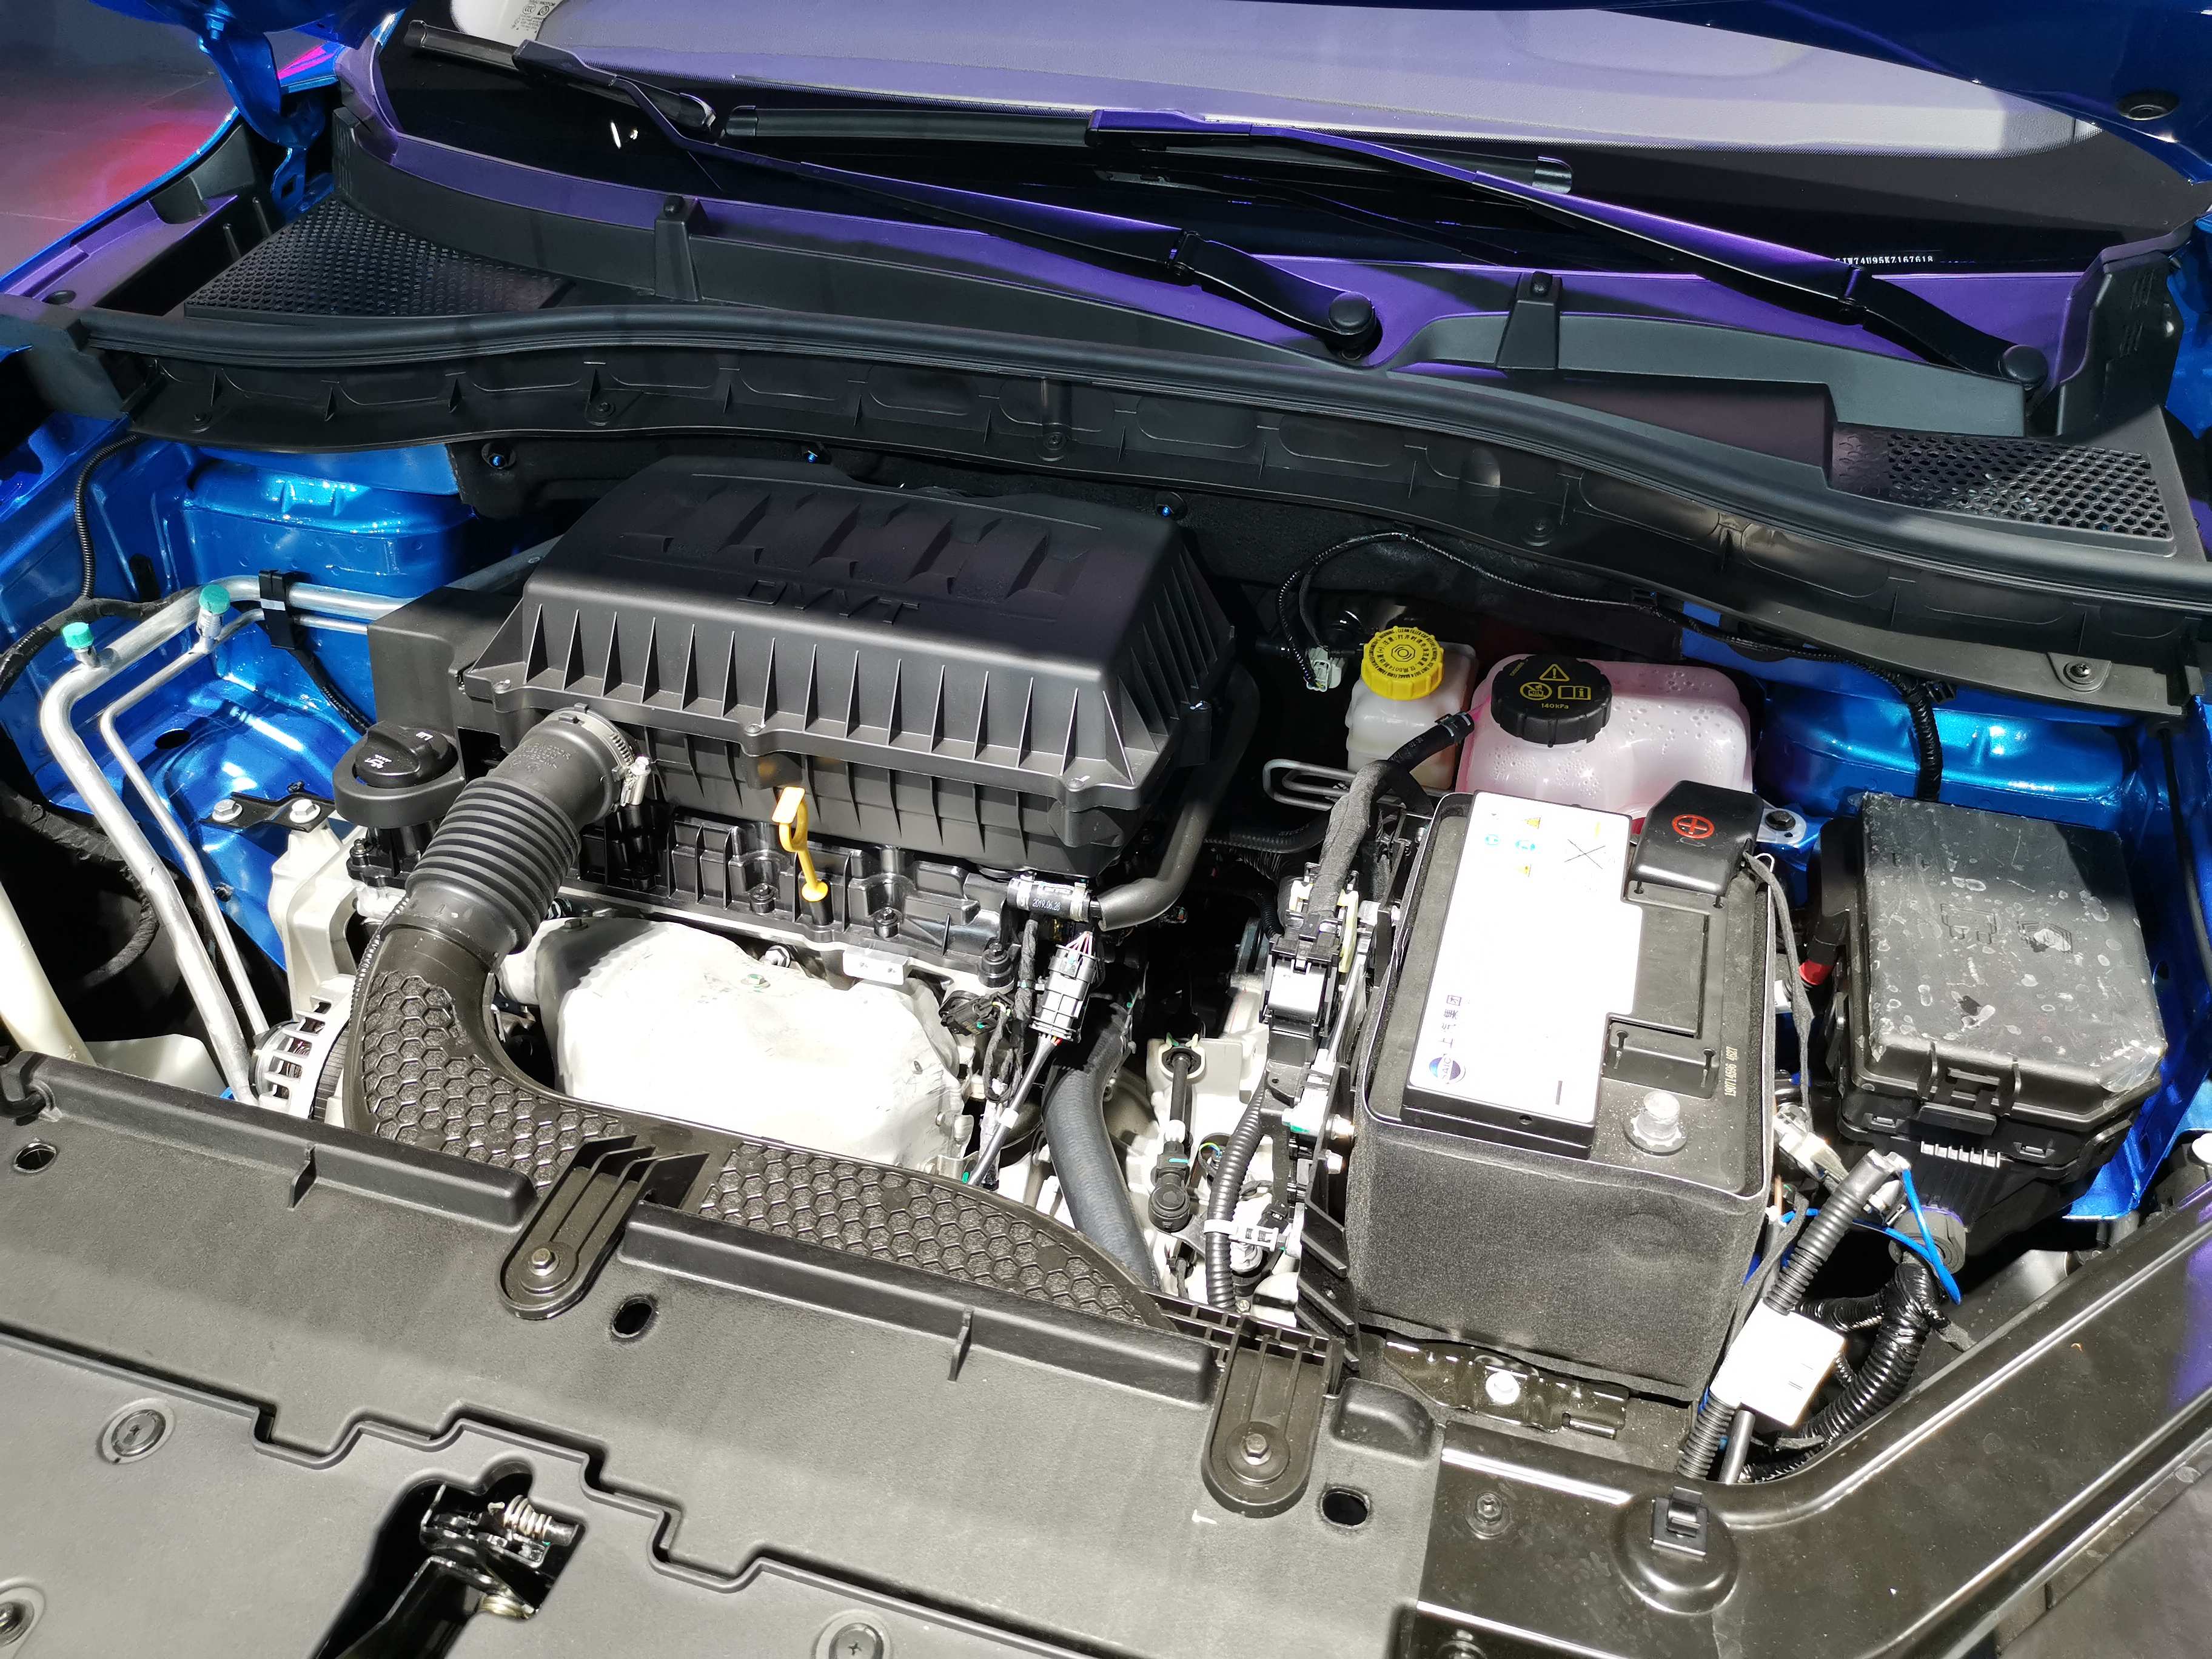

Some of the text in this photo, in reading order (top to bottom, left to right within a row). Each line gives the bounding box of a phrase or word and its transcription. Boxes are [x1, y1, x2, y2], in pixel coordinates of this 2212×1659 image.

[1032, 898, 1062, 911] 2019.06.28
[1724, 1046, 1738, 1097] 190714596 4627
